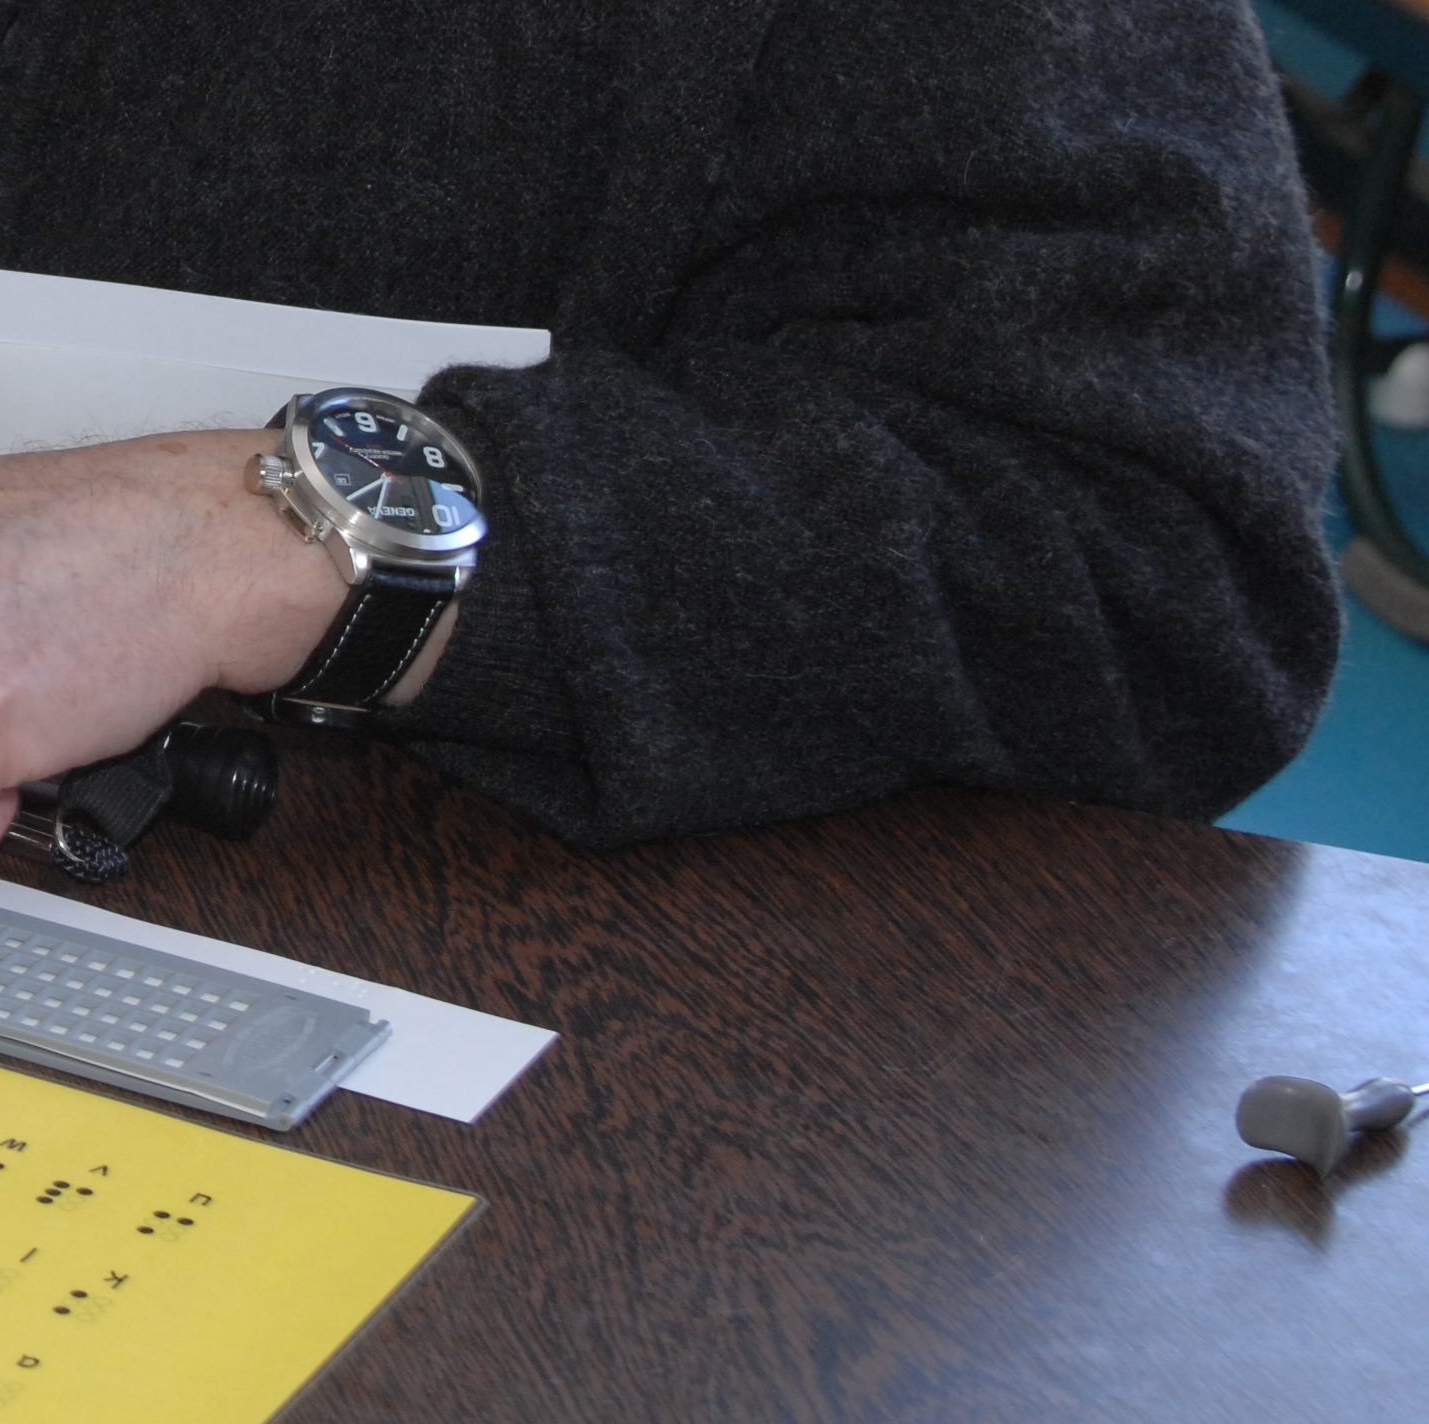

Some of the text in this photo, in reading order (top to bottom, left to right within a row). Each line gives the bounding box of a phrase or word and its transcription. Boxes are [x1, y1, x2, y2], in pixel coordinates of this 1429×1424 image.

[423, 446, 445, 468] 8
[367, 505, 416, 518] GENEVA
[432, 504, 461, 527] 10
[90, 1165, 108, 1176] v
[189, 1193, 213, 1206] u
[104, 1271, 128, 1289] k
[17, 1355, 40, 1368] a
